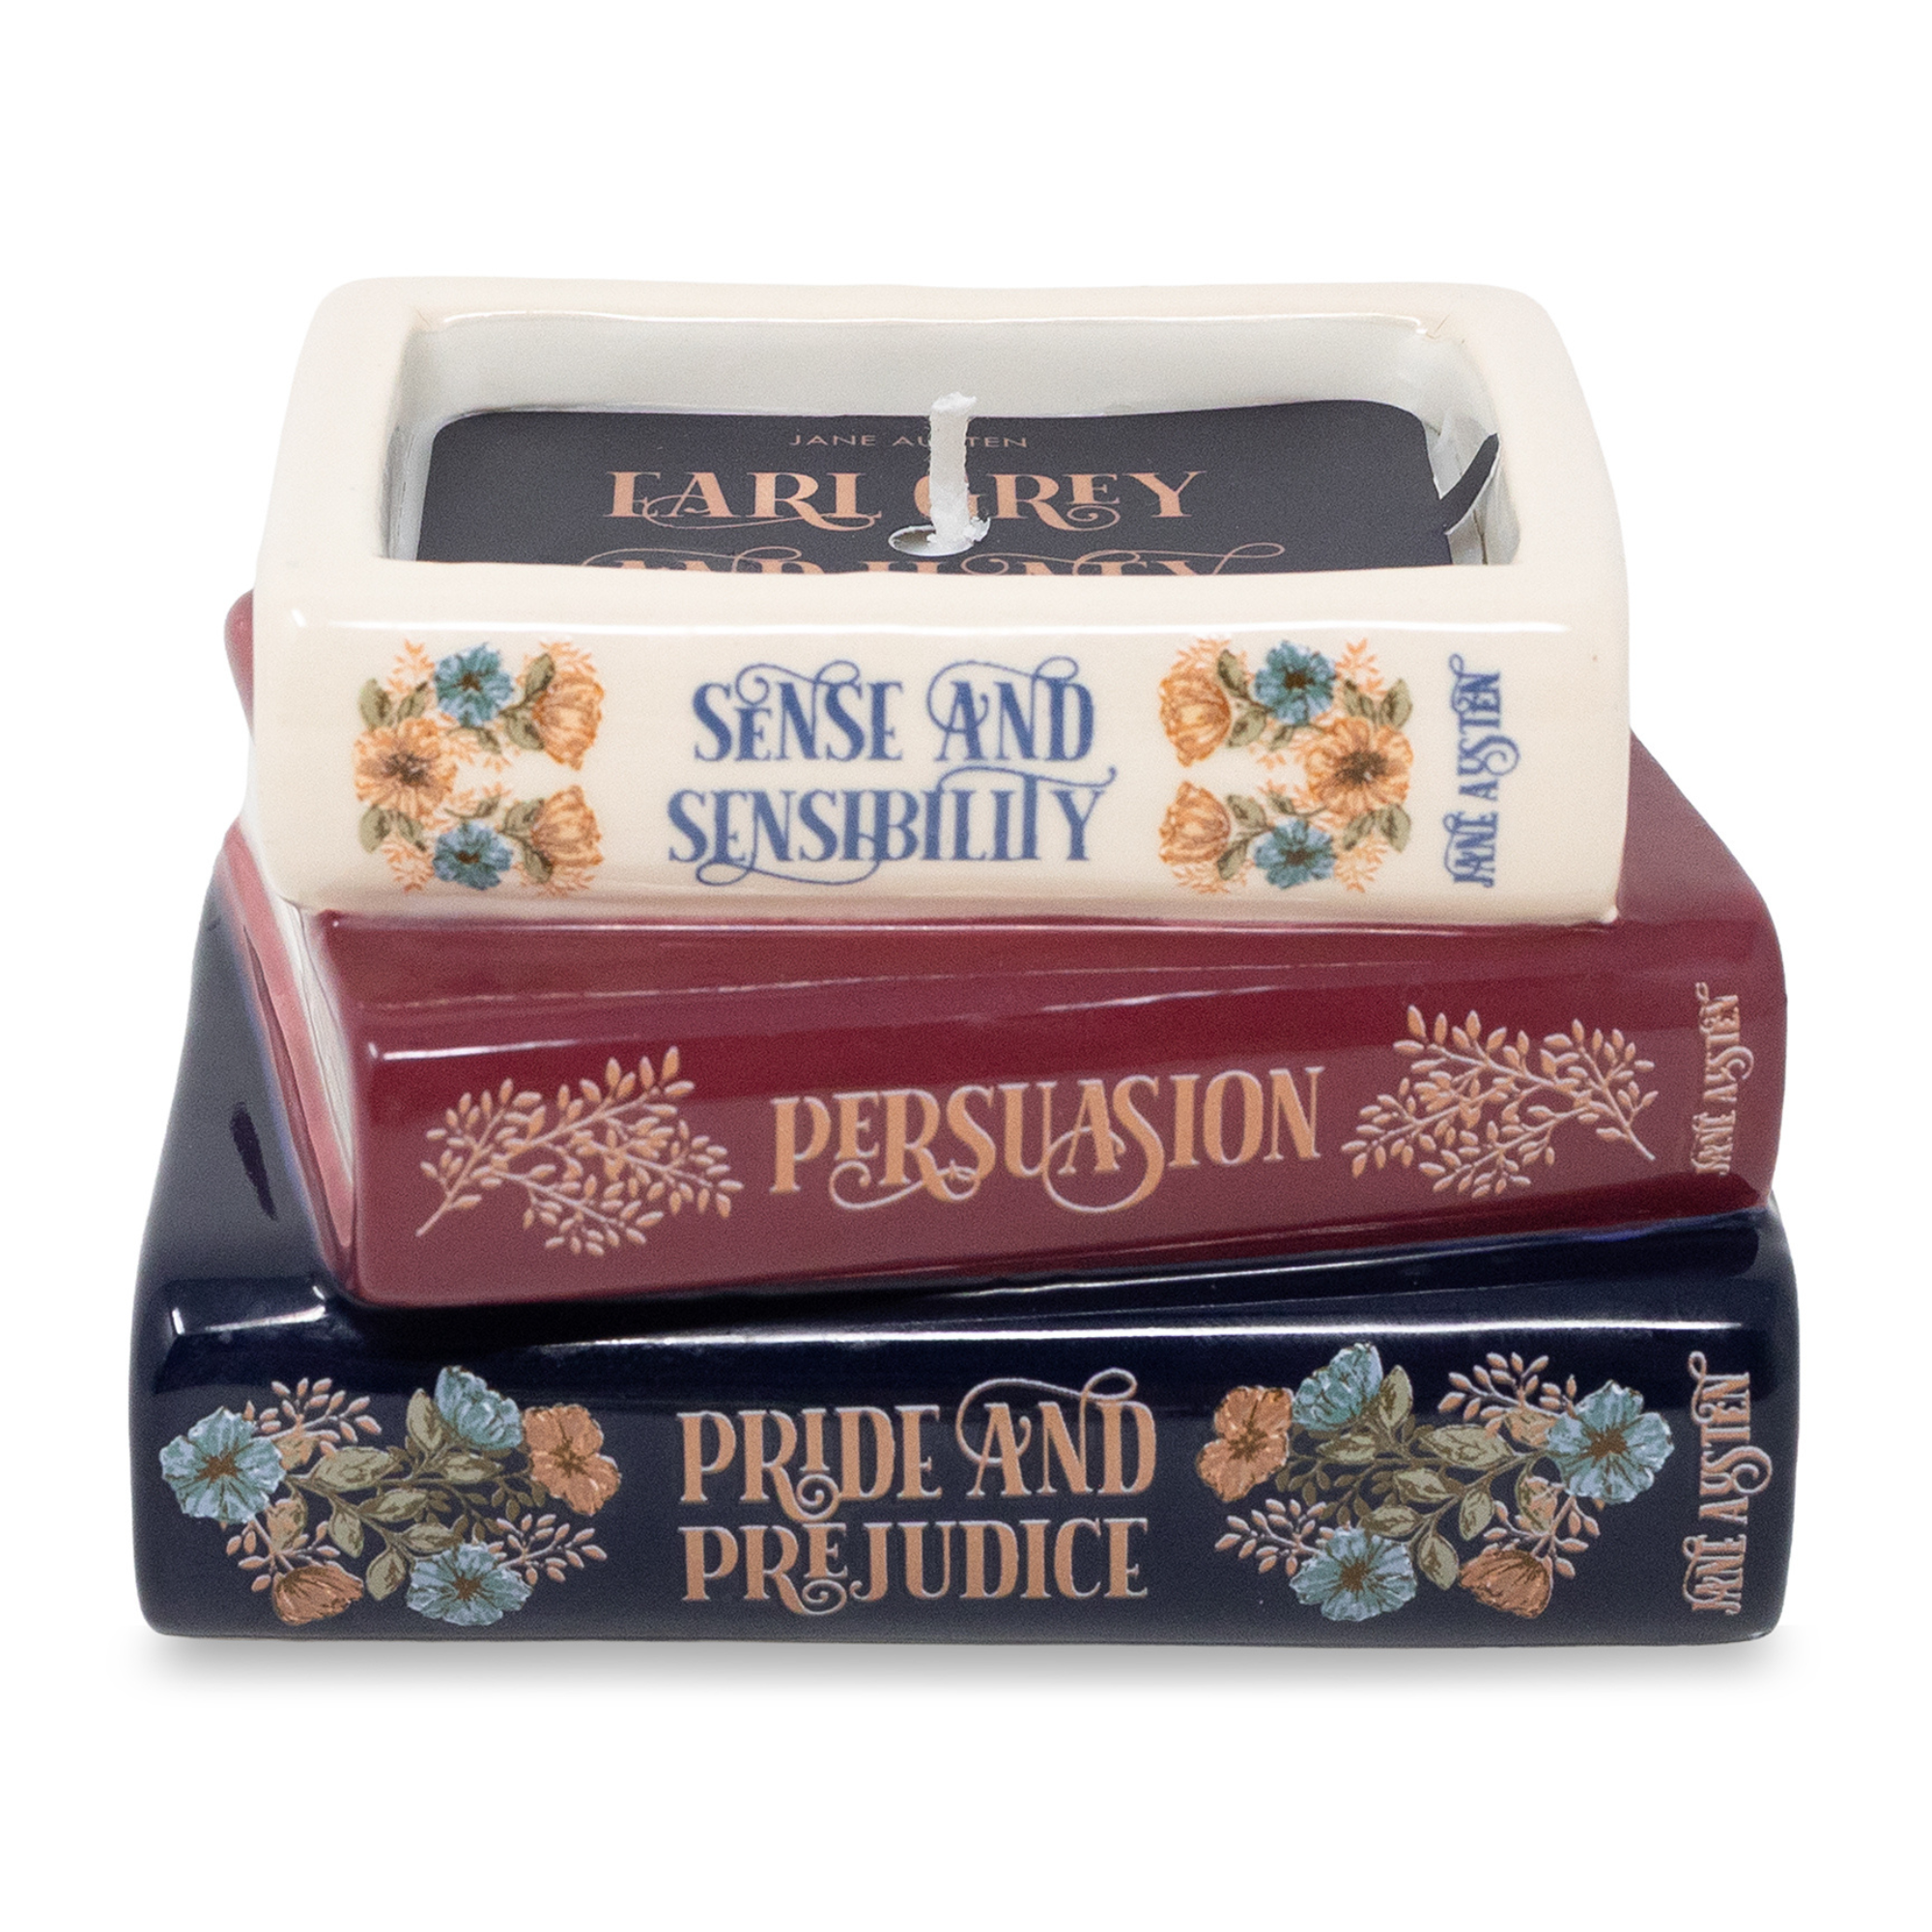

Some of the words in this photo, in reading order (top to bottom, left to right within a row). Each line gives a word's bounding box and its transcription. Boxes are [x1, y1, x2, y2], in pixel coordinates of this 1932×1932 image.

[789, 434, 877, 447] JANE
[892, 435, 1028, 448] AUTEN
[603, 470, 883, 531] EARL
[692, 660, 904, 762] SENSE
[926, 655, 1094, 762] AND
[1448, 653, 1520, 801] AUSTEN
[667, 765, 1117, 886] SENSIBILITY
[1442, 810, 1498, 888] JANE
[1695, 981, 1754, 1102] AUSTEN
[770, 1065, 1325, 1213] PERSUASION
[1690, 1109, 1736, 1176] JANE
[676, 1404, 943, 1523] PRIDE
[955, 1368, 1157, 1497] AND
[1688, 1350, 1773, 1525] AUSTEN
[677, 1518, 1149, 1616] PREJUDICE
[1682, 1533, 1747, 1615] JANE
